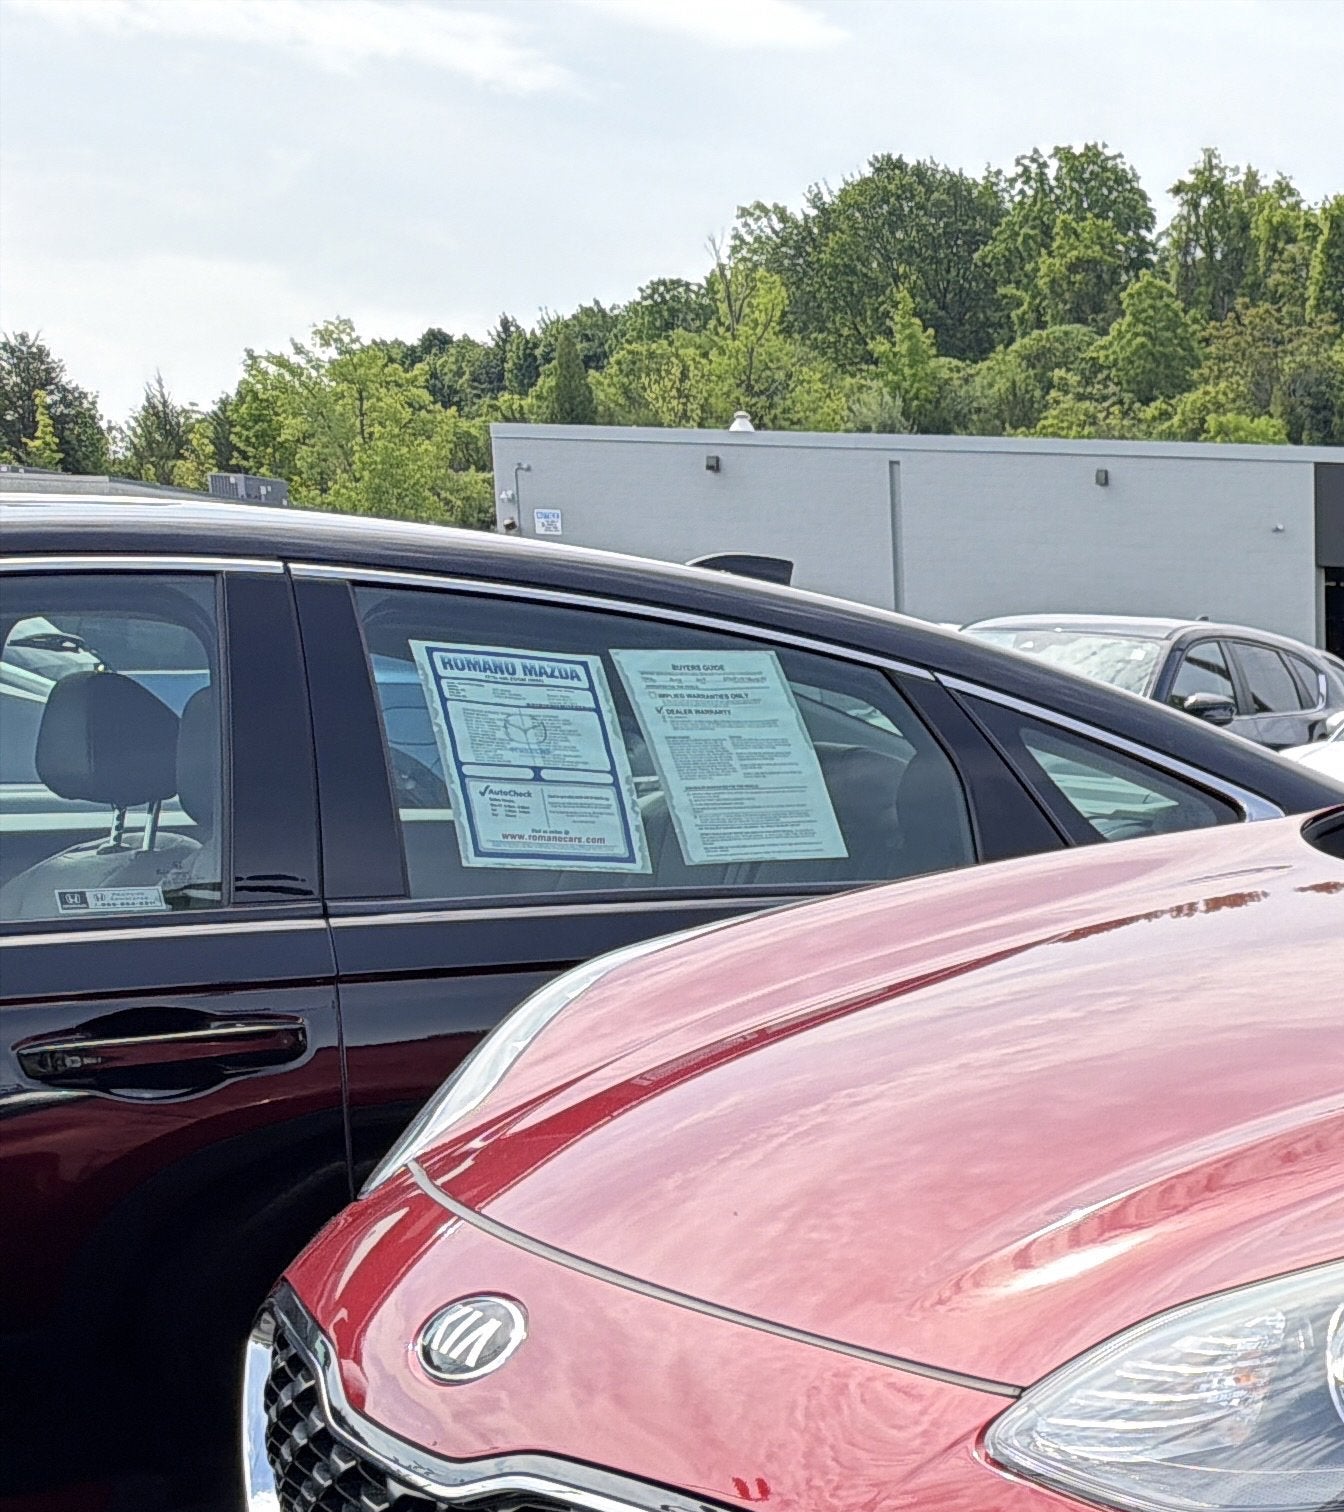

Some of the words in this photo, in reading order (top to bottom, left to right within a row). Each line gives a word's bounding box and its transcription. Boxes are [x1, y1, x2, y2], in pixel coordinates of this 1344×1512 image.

[439, 654, 517, 676] ROMANO
[521, 661, 582, 682] MAZDA
[488, 788, 533, 798] AutoCheck
[501, 832, 606, 845] www.romanocars.com
[423, 1303, 503, 1368] KIA
